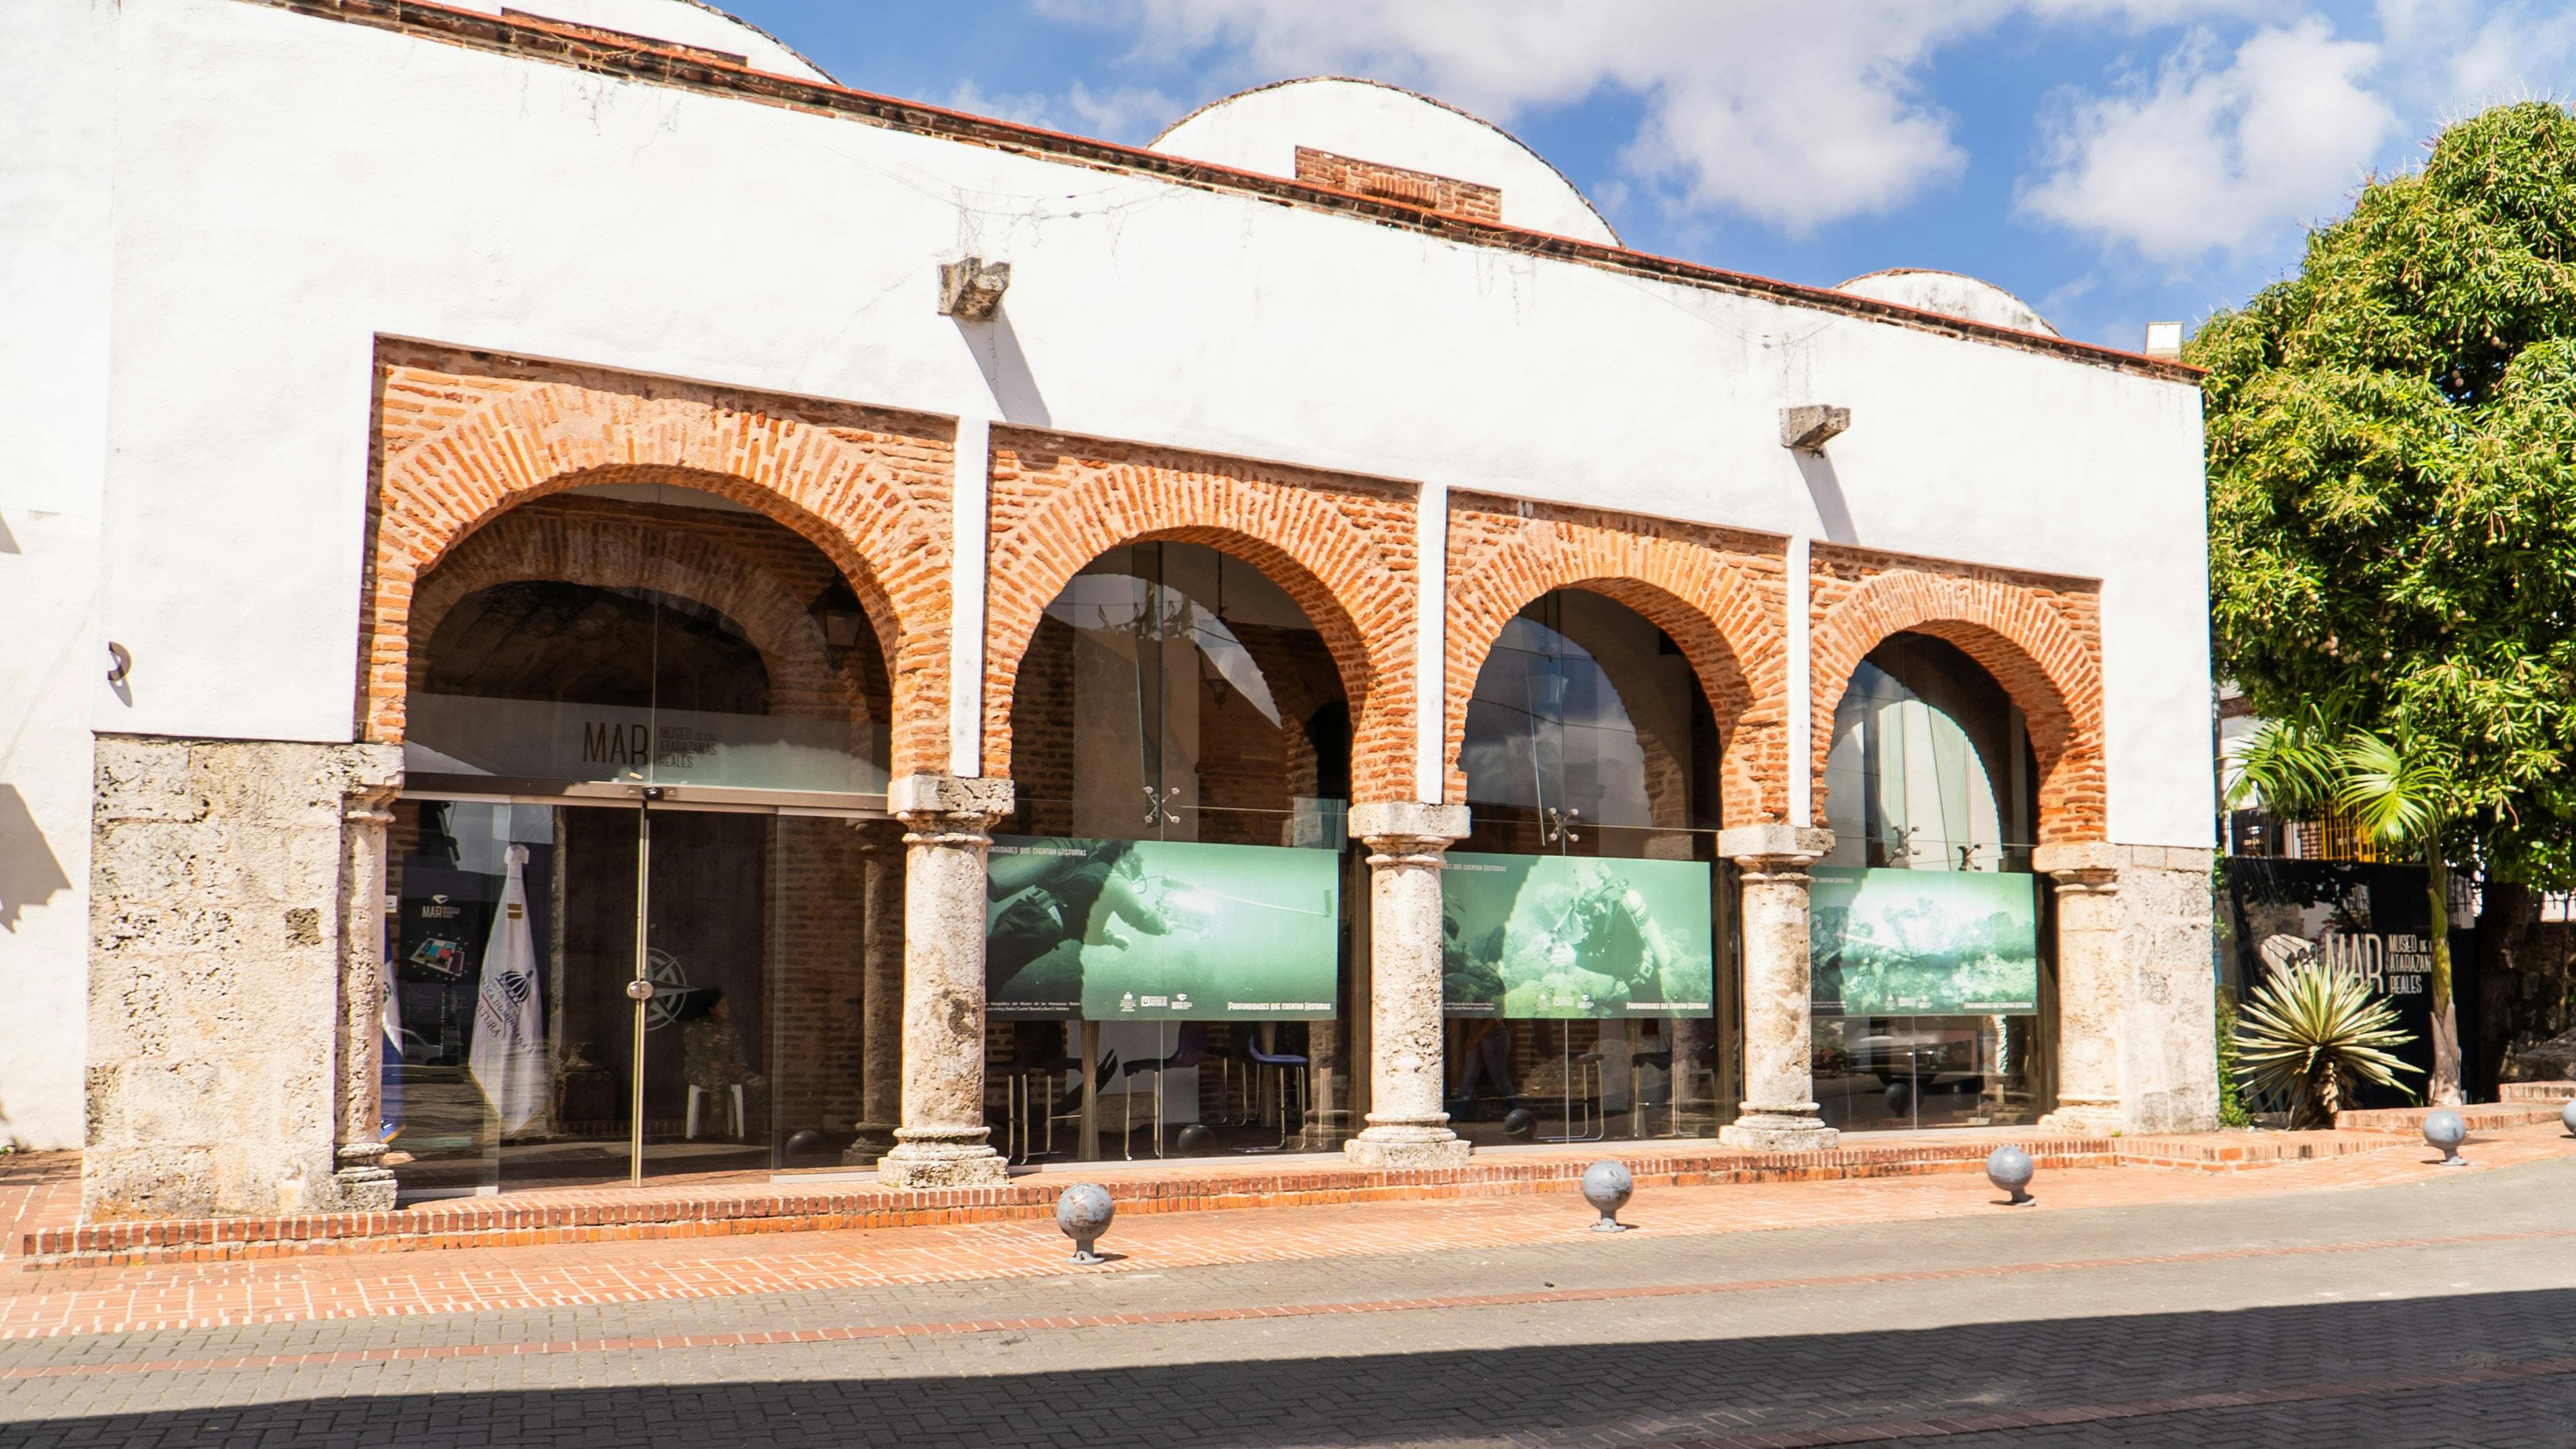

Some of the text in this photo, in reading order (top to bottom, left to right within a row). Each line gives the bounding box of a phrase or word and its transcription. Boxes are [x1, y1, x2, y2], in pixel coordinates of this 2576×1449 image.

[660, 726, 692, 740] MUSEO
[582, 721, 648, 765] MAR
[659, 740, 717, 756] ATARAZANAS
[659, 753, 694, 768] REALES
[422, 905, 442, 918] MAR
[2389, 934, 2418, 953] MUSEO
[2325, 933, 2384, 994] MAR
[2389, 953, 2432, 972] ATARAZAN
[2390, 974, 2423, 994] REALES
